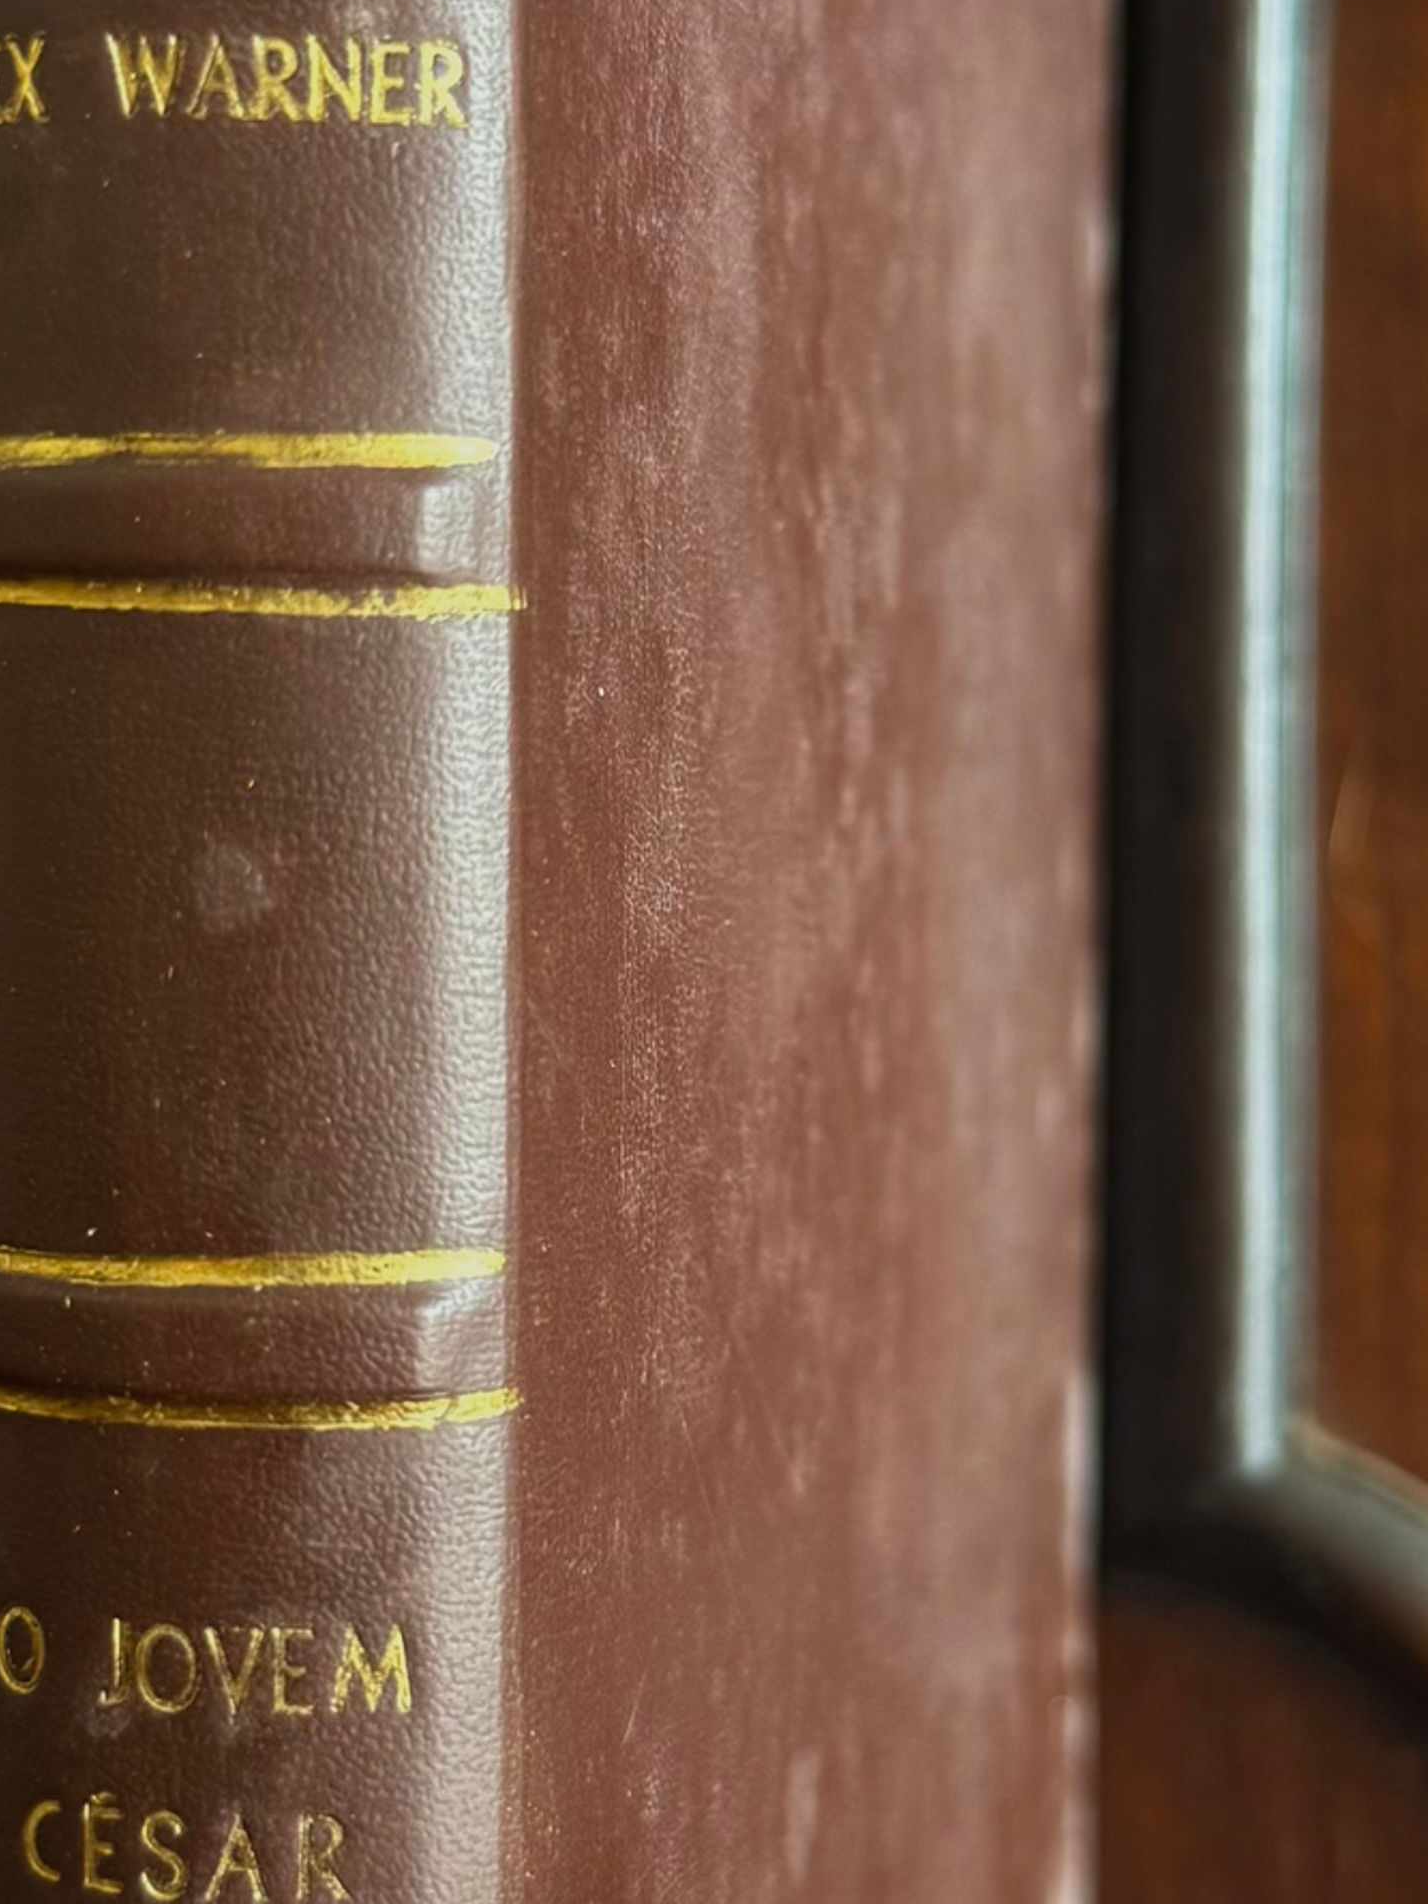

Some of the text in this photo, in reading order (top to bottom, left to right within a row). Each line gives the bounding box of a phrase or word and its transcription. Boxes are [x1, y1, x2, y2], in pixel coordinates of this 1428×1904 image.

[104, 31, 468, 130] WARNER
[98, 1616, 413, 1724] JOVEM
[22, 1791, 352, 1902] CÉSAR
